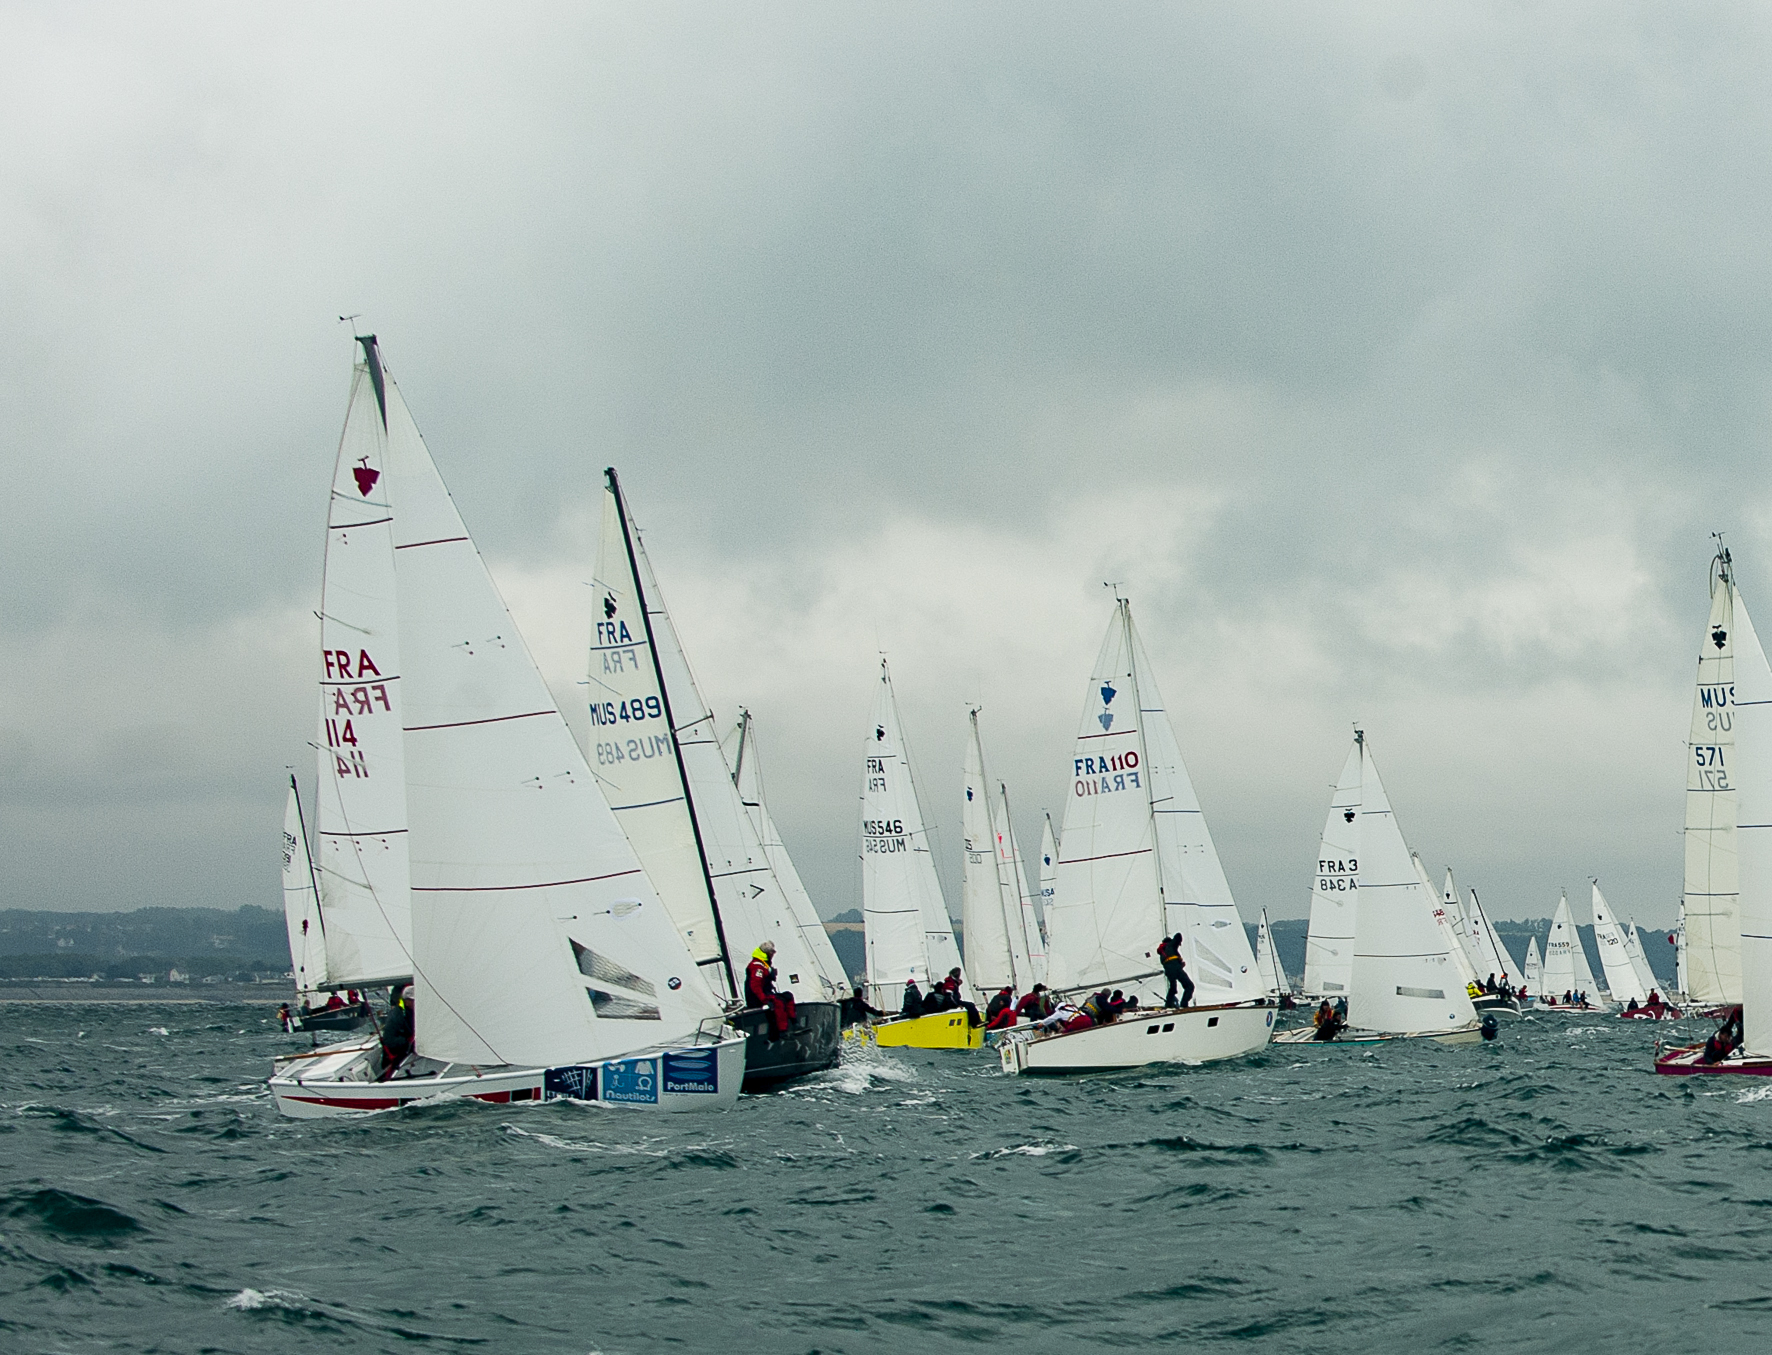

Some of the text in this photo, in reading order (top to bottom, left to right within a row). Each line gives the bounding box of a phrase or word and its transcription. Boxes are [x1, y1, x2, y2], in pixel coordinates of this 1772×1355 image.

[597, 620, 632, 645] FRA
[323, 649, 381, 679] FRA
[325, 718, 358, 747] 114
[1696, 747, 1724, 766] 571
[867, 759, 885, 774] FRA
[667, 1081, 714, 1091] PortMalo
[605, 1090, 655, 1102] Nautilots
